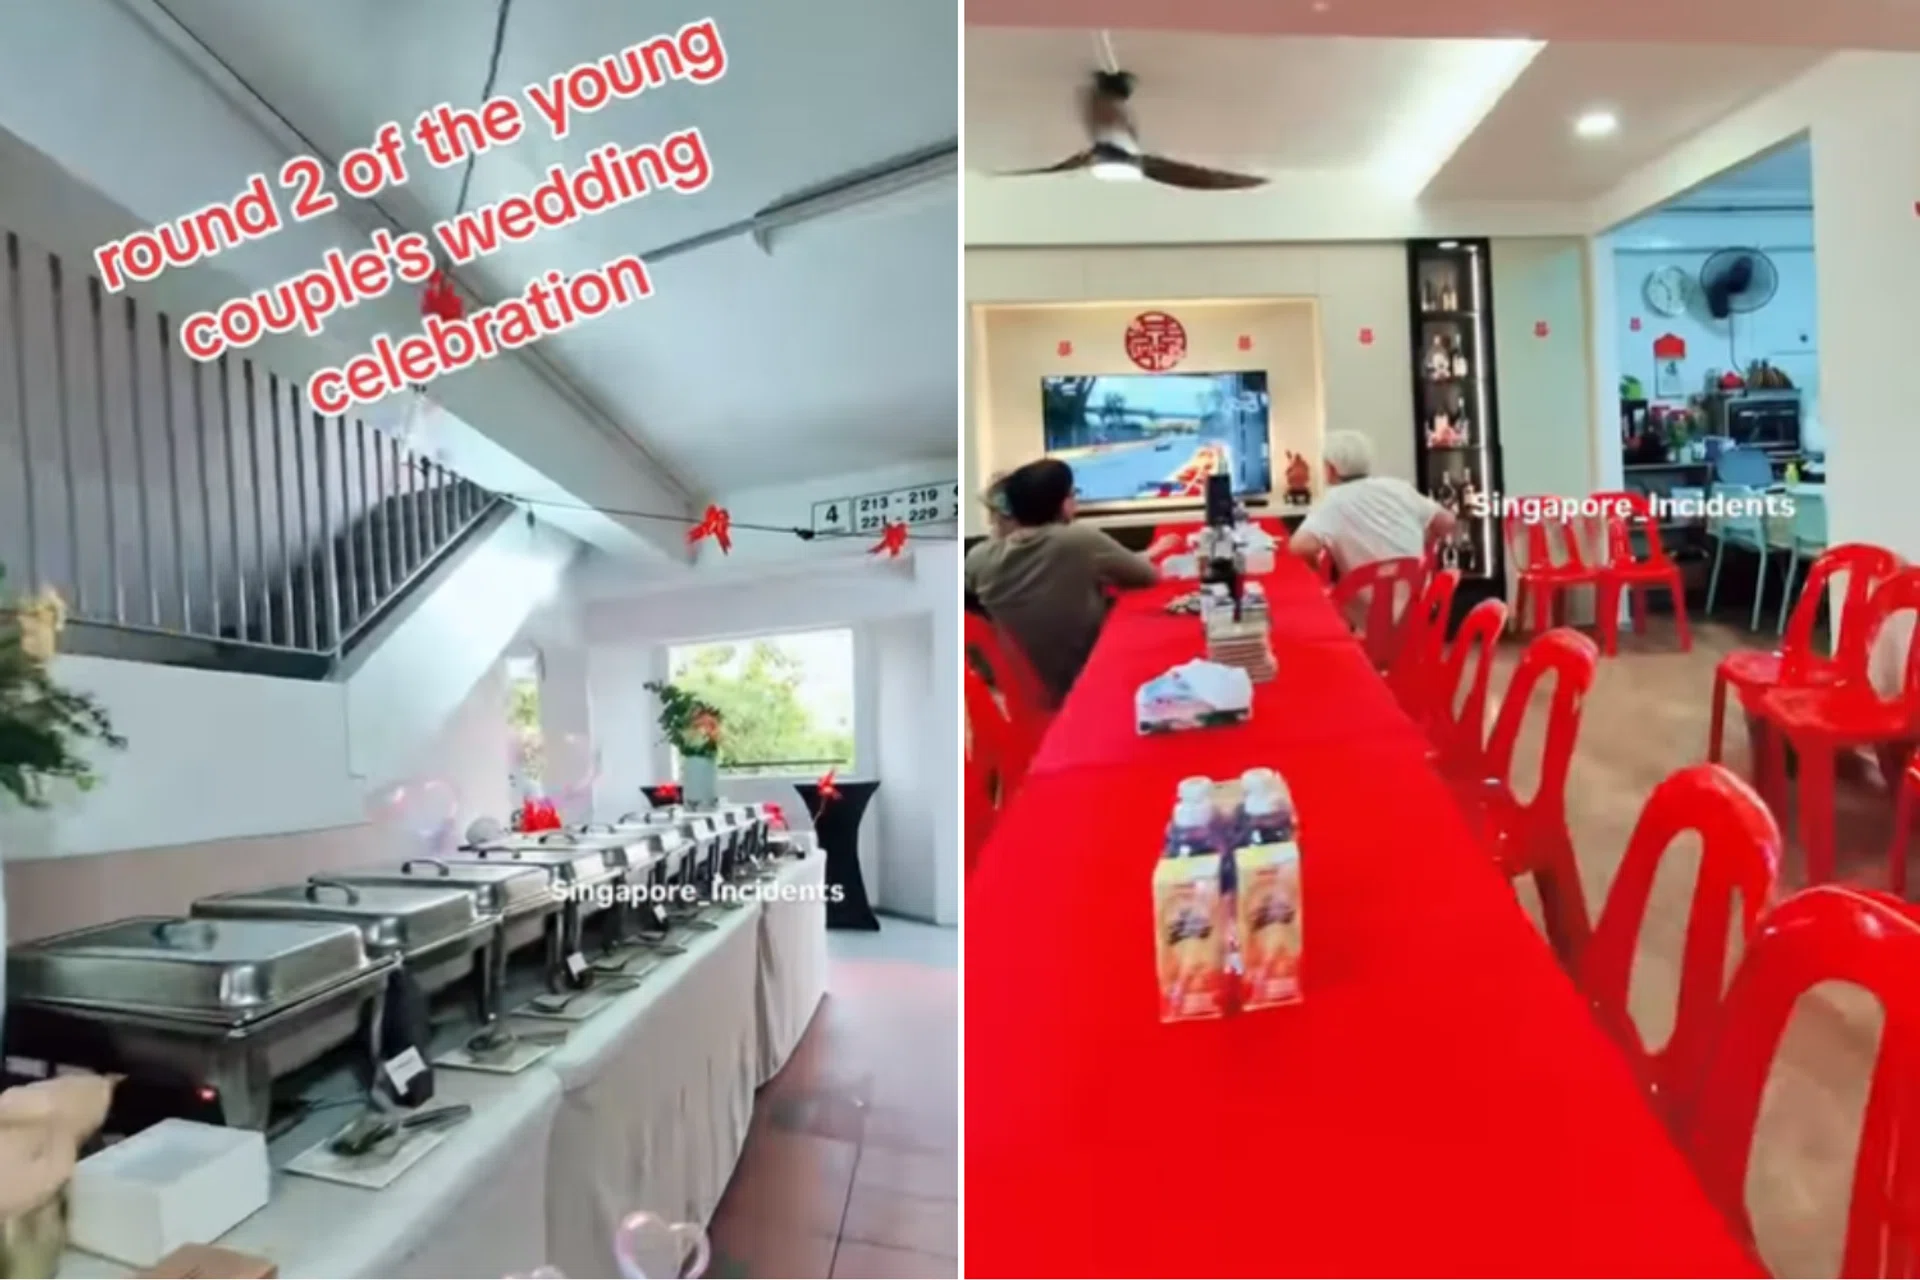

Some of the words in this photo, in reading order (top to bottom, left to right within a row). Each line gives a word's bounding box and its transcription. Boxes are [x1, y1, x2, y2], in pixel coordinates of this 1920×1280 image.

[860, 496, 889, 511] 213
[909, 488, 938, 504] 219
[825, 505, 839, 523] 4
[861, 514, 888, 529] 221
